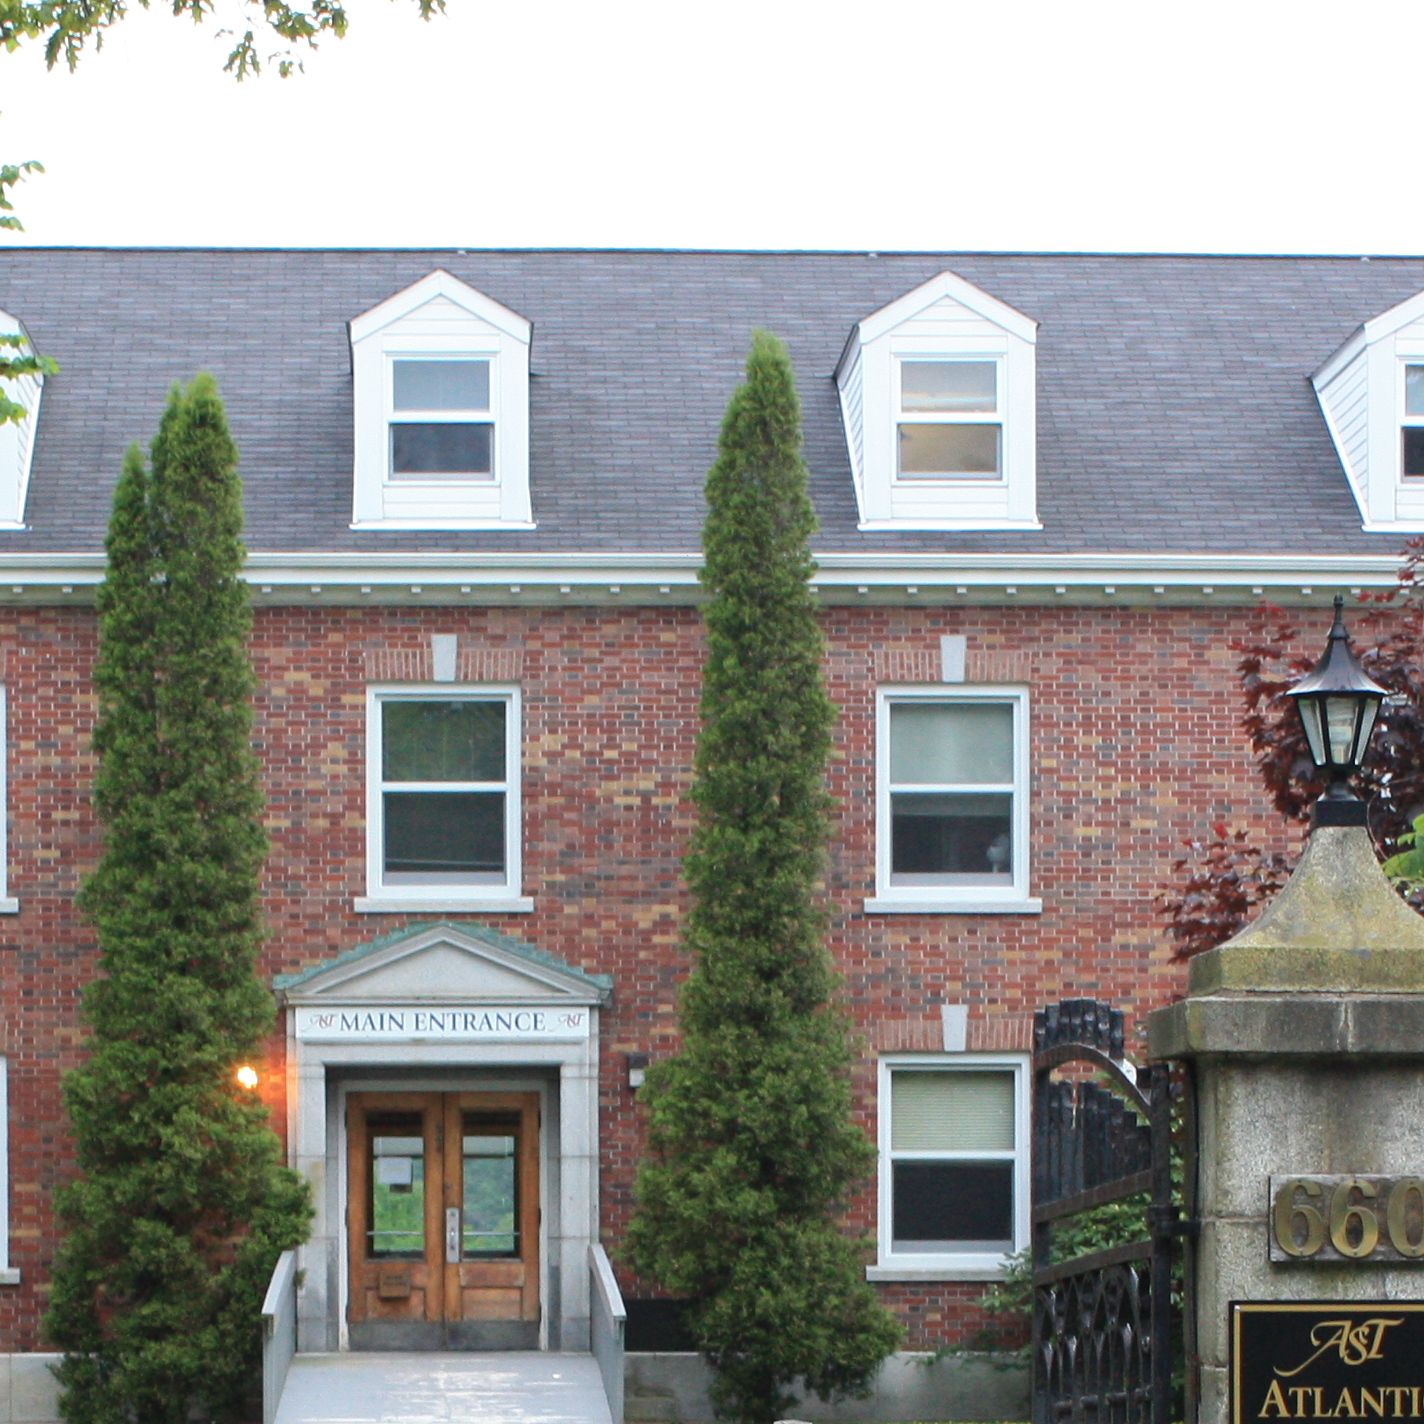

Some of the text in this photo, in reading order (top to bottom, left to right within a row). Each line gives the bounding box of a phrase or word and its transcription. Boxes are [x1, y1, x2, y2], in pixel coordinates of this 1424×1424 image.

[339, 1012, 405, 1032] MAIN
[413, 1012, 547, 1032] ENTRANCE
[1273, 1317, 1405, 1378] AST
